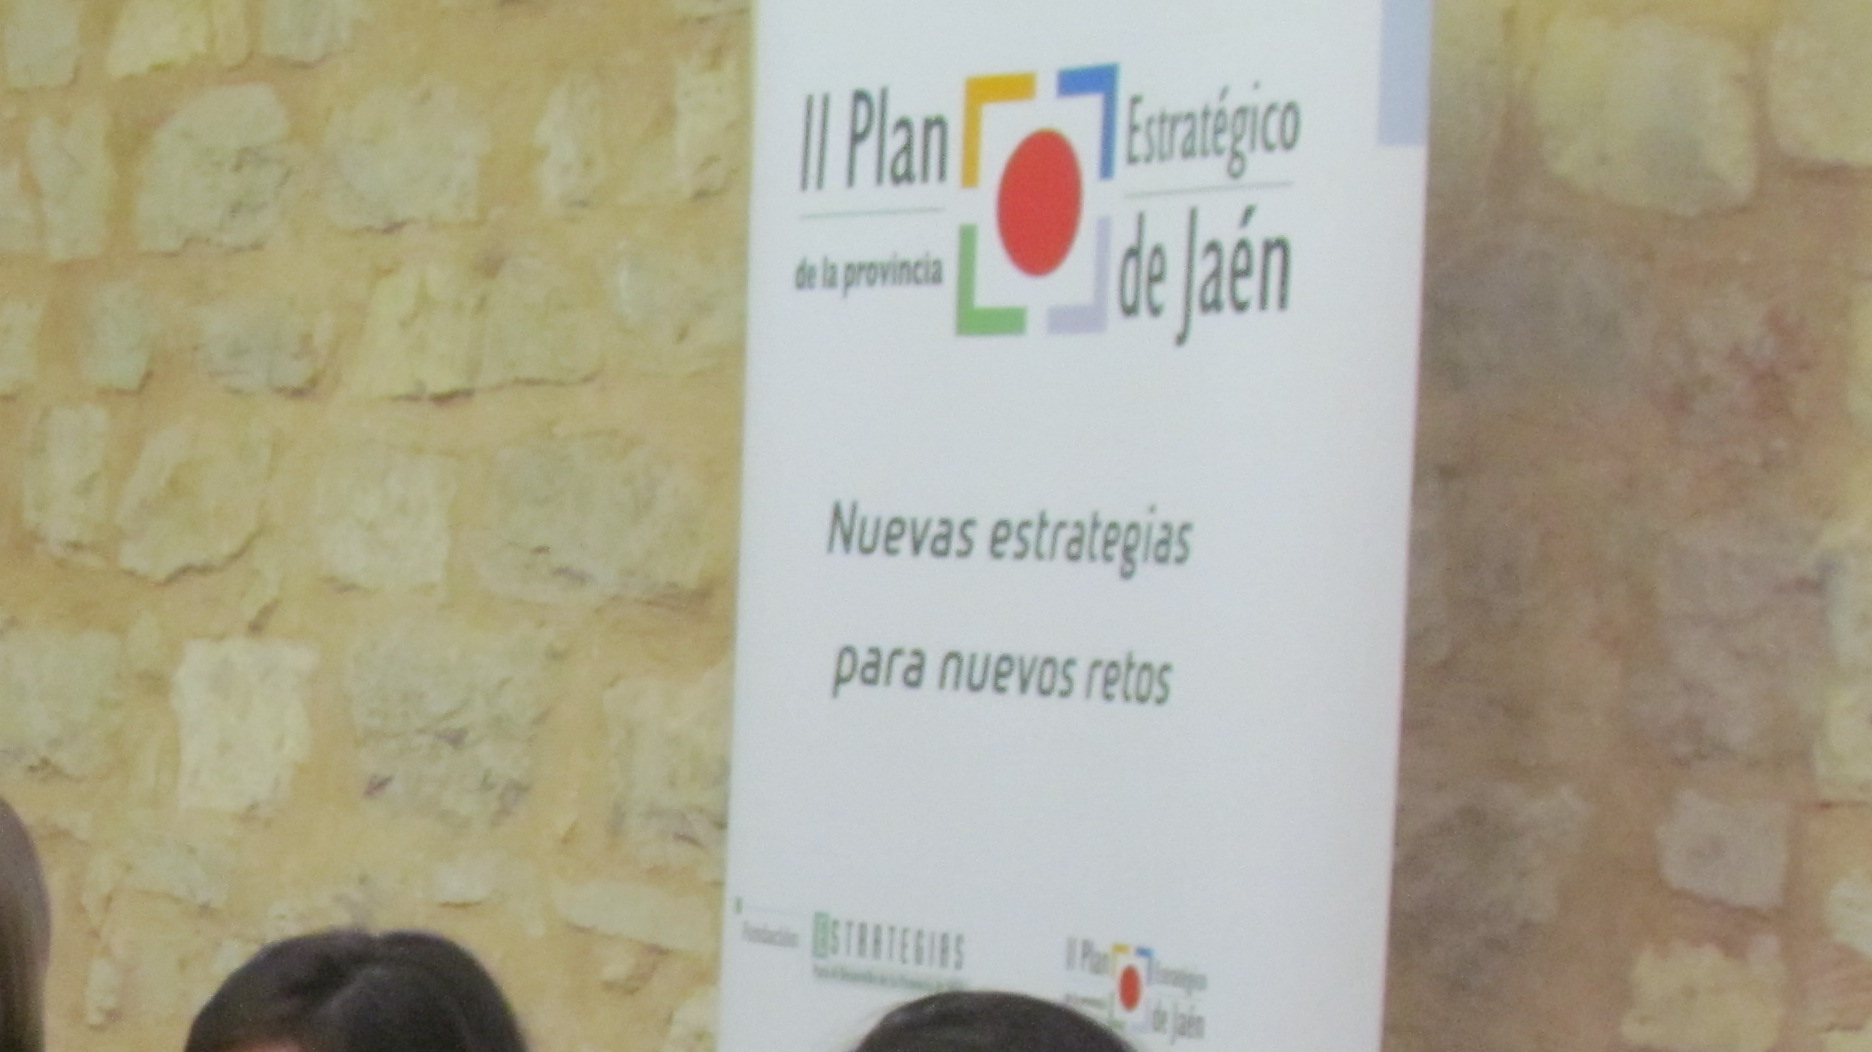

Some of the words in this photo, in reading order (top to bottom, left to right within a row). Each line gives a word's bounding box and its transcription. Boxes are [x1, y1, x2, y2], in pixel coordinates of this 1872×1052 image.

[847, 84, 948, 188] Plan
[1127, 80, 1301, 180] Estratégico
[794, 256, 817, 290] de
[822, 255, 839, 289] la
[842, 251, 944, 298] provincia
[1119, 211, 1167, 317] de
[1174, 205, 1292, 346] Jaén
[827, 500, 977, 560] Nuevas
[989, 504, 1194, 580] estrategias
[832, 644, 926, 700] para
[938, 650, 1079, 700] nuevos
[1085, 650, 1174, 706] retos
